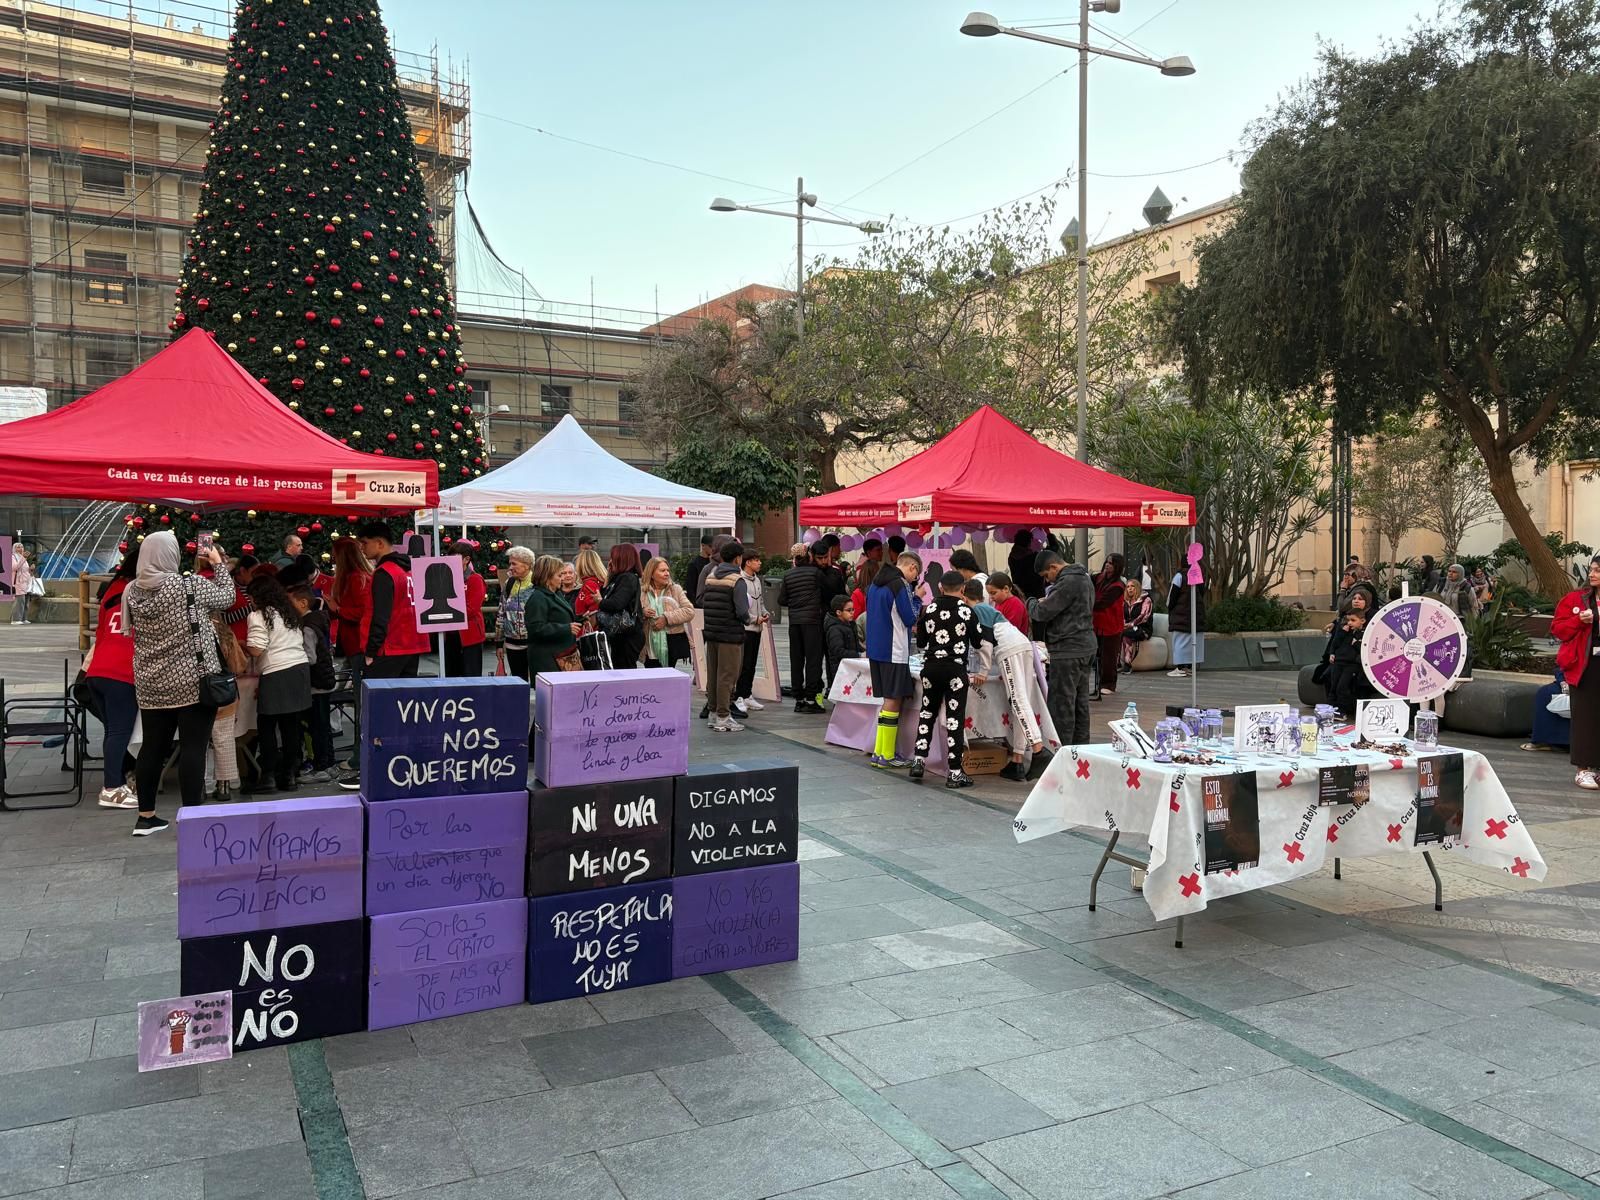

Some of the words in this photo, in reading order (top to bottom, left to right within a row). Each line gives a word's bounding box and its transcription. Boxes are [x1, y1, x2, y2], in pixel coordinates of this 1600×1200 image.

[108, 468, 138, 480] Cada
[143, 472, 163, 482] vez
[168, 472, 193, 484] más
[198, 474, 230, 486] cerca
[235, 476, 248, 487] de
[253, 476, 270, 488] las
[274, 479, 323, 490] personas
[369, 480, 394, 493] Cruz
[398, 482, 421, 496] Roja
[698, 510, 707, 518] Roja
[1029, 507, 1044, 515] Cada
[1159, 508, 1173, 516] Cruz
[1174, 509, 1187, 518] Roja
[397, 698, 476, 723] VIVAS
[579, 684, 600, 713] Ni
[614, 693, 662, 708] sumisa
[583, 715, 595, 727] ni
[605, 706, 656, 727] devota
[443, 727, 500, 753] NOS
[584, 730, 600, 748] te
[604, 730, 637, 752] quiero
[645, 723, 676, 738] libre
[583, 751, 616, 770] linda
[621, 757, 632, 771] y
[632, 746, 662, 764] loca
[1421, 761, 1431, 774] ESTO
[388, 753, 516, 790] QUEREMOS
[1428, 774, 1434, 786] ES
[690, 787, 776, 808] DIGAMOS
[1206, 780, 1220, 794] ESTO
[1421, 785, 1438, 799] NORMAL
[614, 795, 658, 828] UNA
[1216, 794, 1222, 808] ES
[385, 808, 429, 840] Por
[442, 812, 472, 836] las
[1207, 808, 1229, 823] NORMAL
[1294, 822, 1310, 840] Cruz
[1303, 804, 1318, 822] Roja
[1336, 809, 1356, 825] Cruz
[1400, 807, 1414, 824] Cruz
[688, 822, 715, 840] NO
[728, 823, 741, 836] A
[752, 819, 776, 834] LA
[204, 821, 341, 866] ROMPAMOS
[691, 842, 786, 864] VIOLENCIA
[386, 851, 472, 872] Valientes
[479, 848, 502, 868] que
[569, 847, 650, 884] MENOS
[256, 864, 287, 884] EL
[377, 881, 395, 892] un
[441, 870, 496, 891] dijeron
[475, 881, 504, 901] NO
[706, 880, 732, 914] NO
[550, 894, 673, 939] RESPETALA
[705, 907, 781, 935] VIOLENCIA
[239, 935, 315, 986] NO
[414, 944, 437, 963] EL
[572, 940, 601, 965] NO
[606, 932, 640, 958] ES
[416, 973, 440, 989] DE
[450, 964, 478, 982] LAS
[488, 957, 516, 976] QUE
[576, 959, 632, 993] TUYA
[259, 988, 293, 1015] es
[418, 987, 445, 1018] NO
[454, 976, 501, 1006] ESTAN
[235, 1009, 298, 1046] NO
